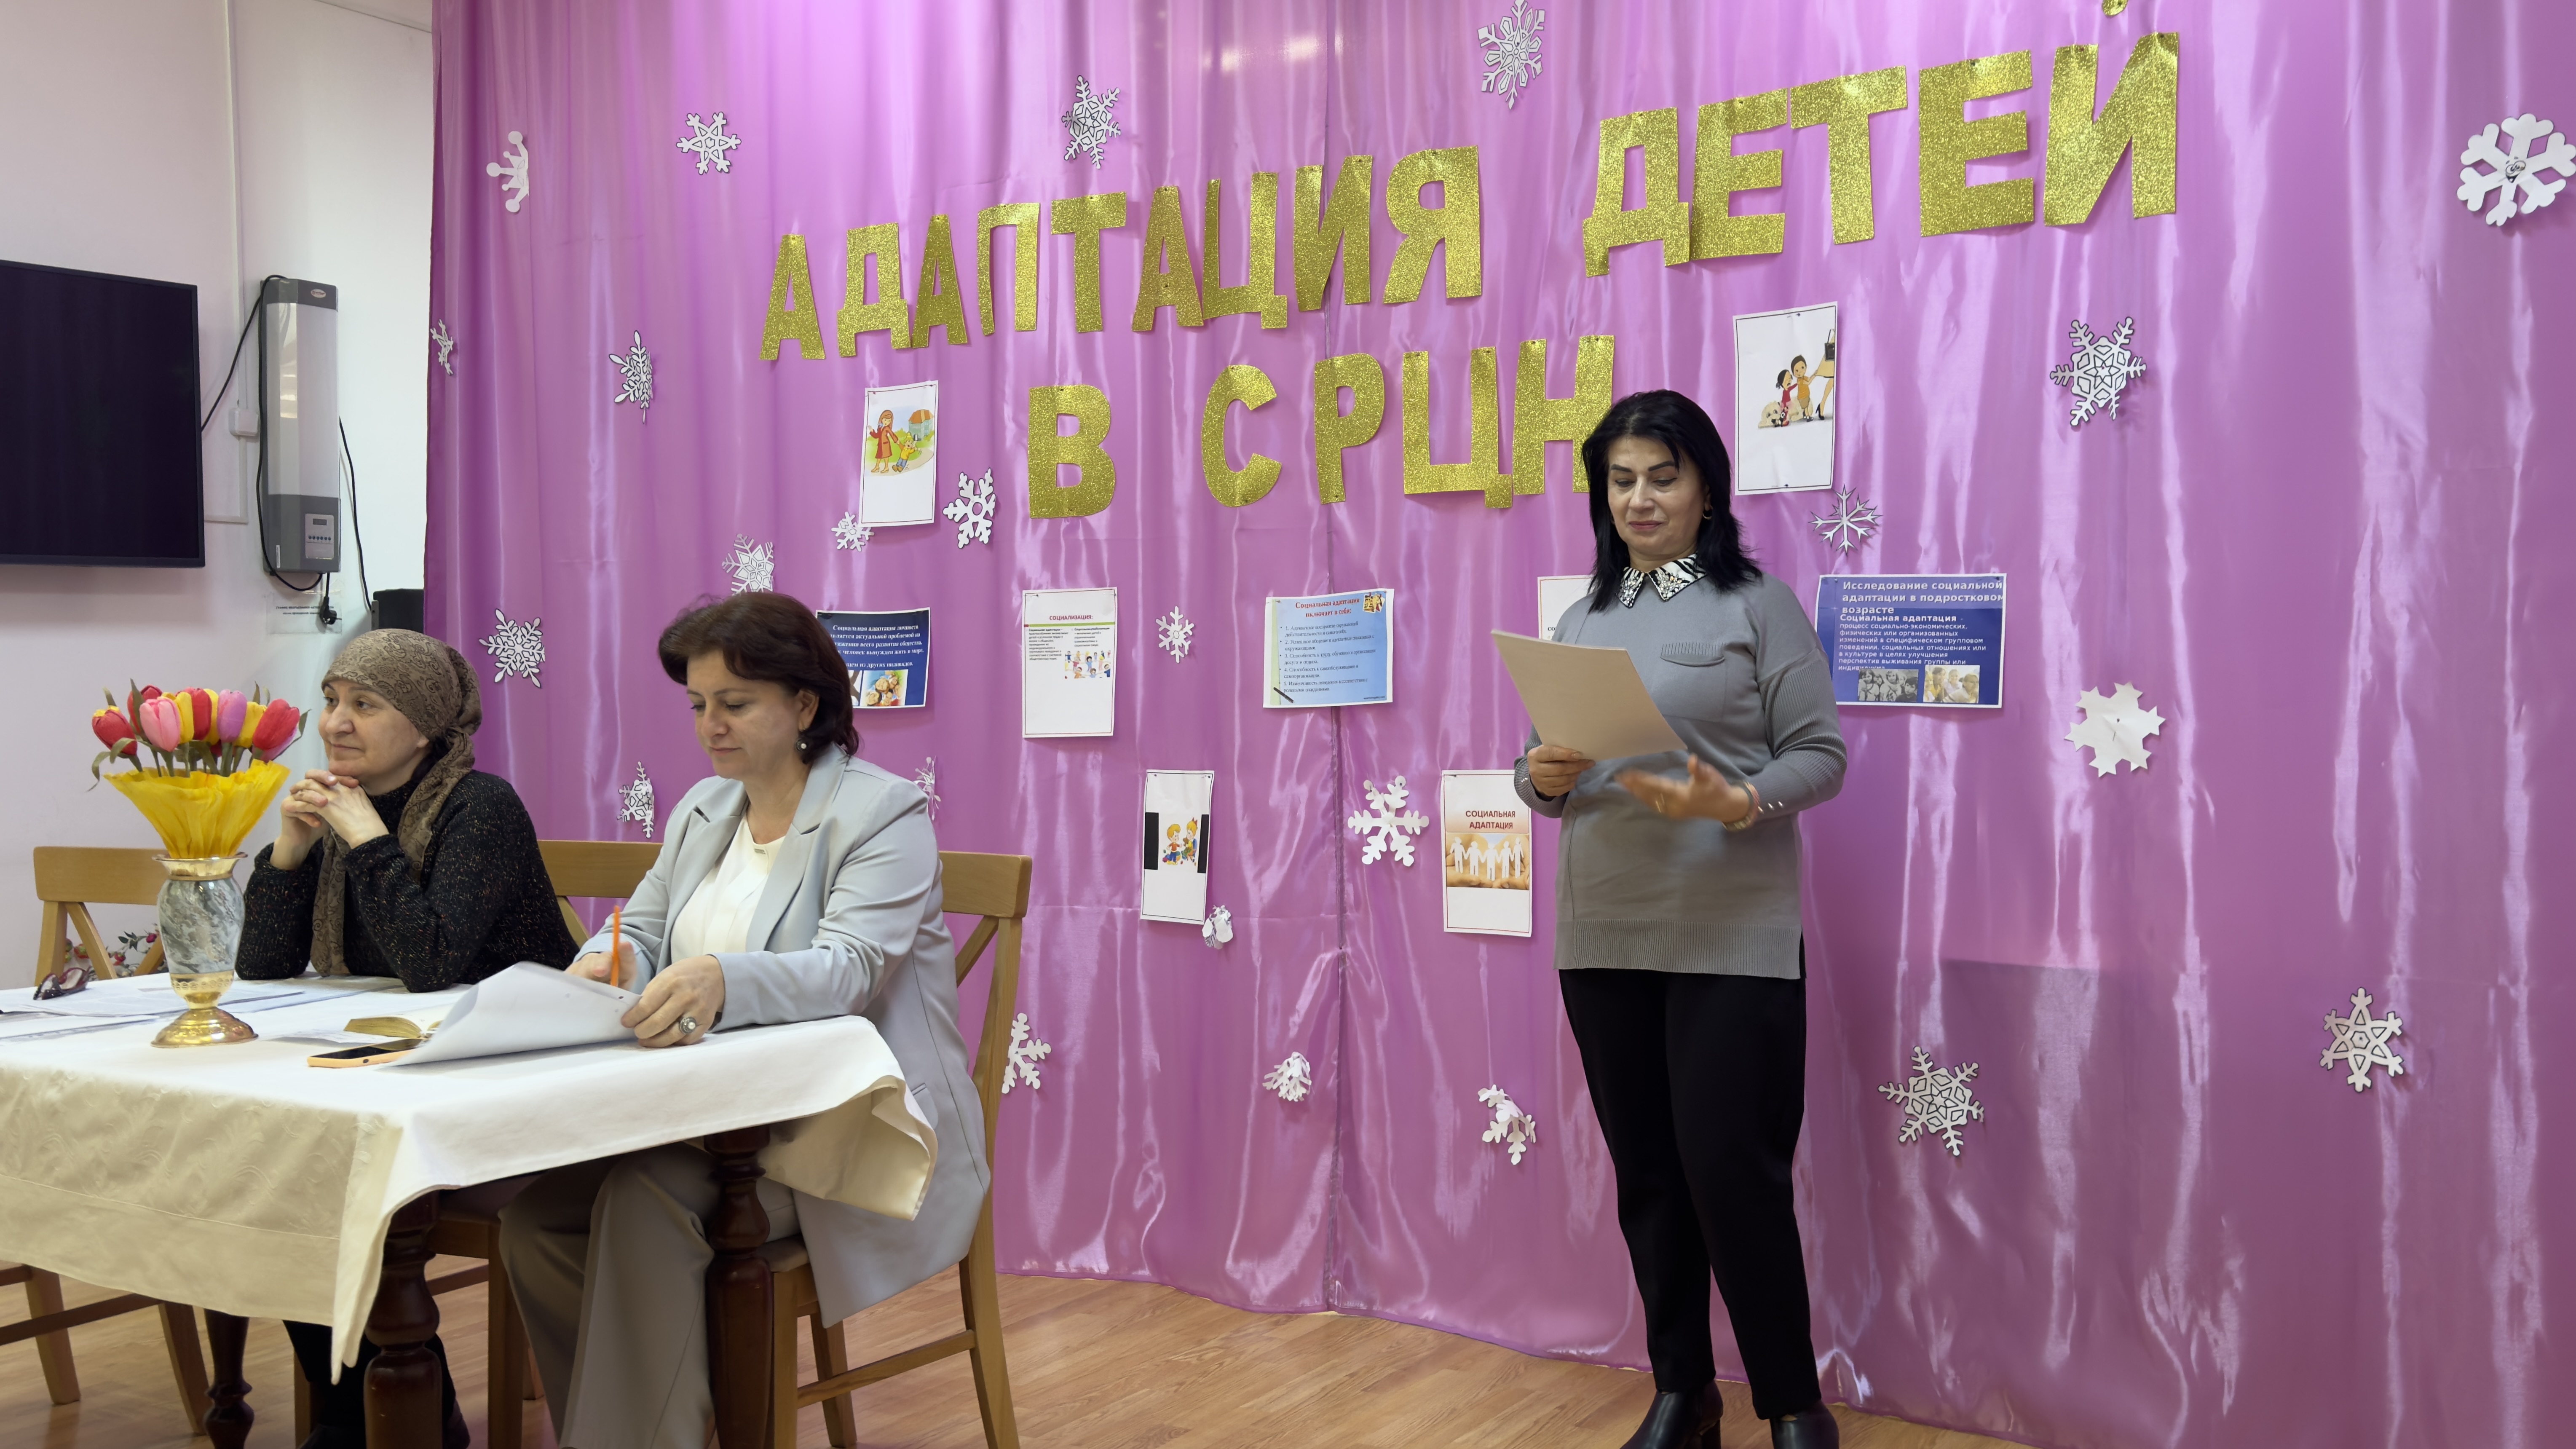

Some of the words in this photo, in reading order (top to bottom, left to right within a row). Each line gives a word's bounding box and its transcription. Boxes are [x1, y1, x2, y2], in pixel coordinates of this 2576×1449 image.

[759, 147, 1482, 361] АДАПТАЦИЯ
[1583, 0, 2180, 277] ДЕТЕЙ
[1028, 384, 1117, 519] В
[1843, 581, 1928, 590] Исследование
[1932, 580, 2002, 591] социальной
[1842, 595, 1906, 603] адаптации
[1920, 594, 2003, 603] подростковом
[1840, 614, 1899, 623] Социальная
